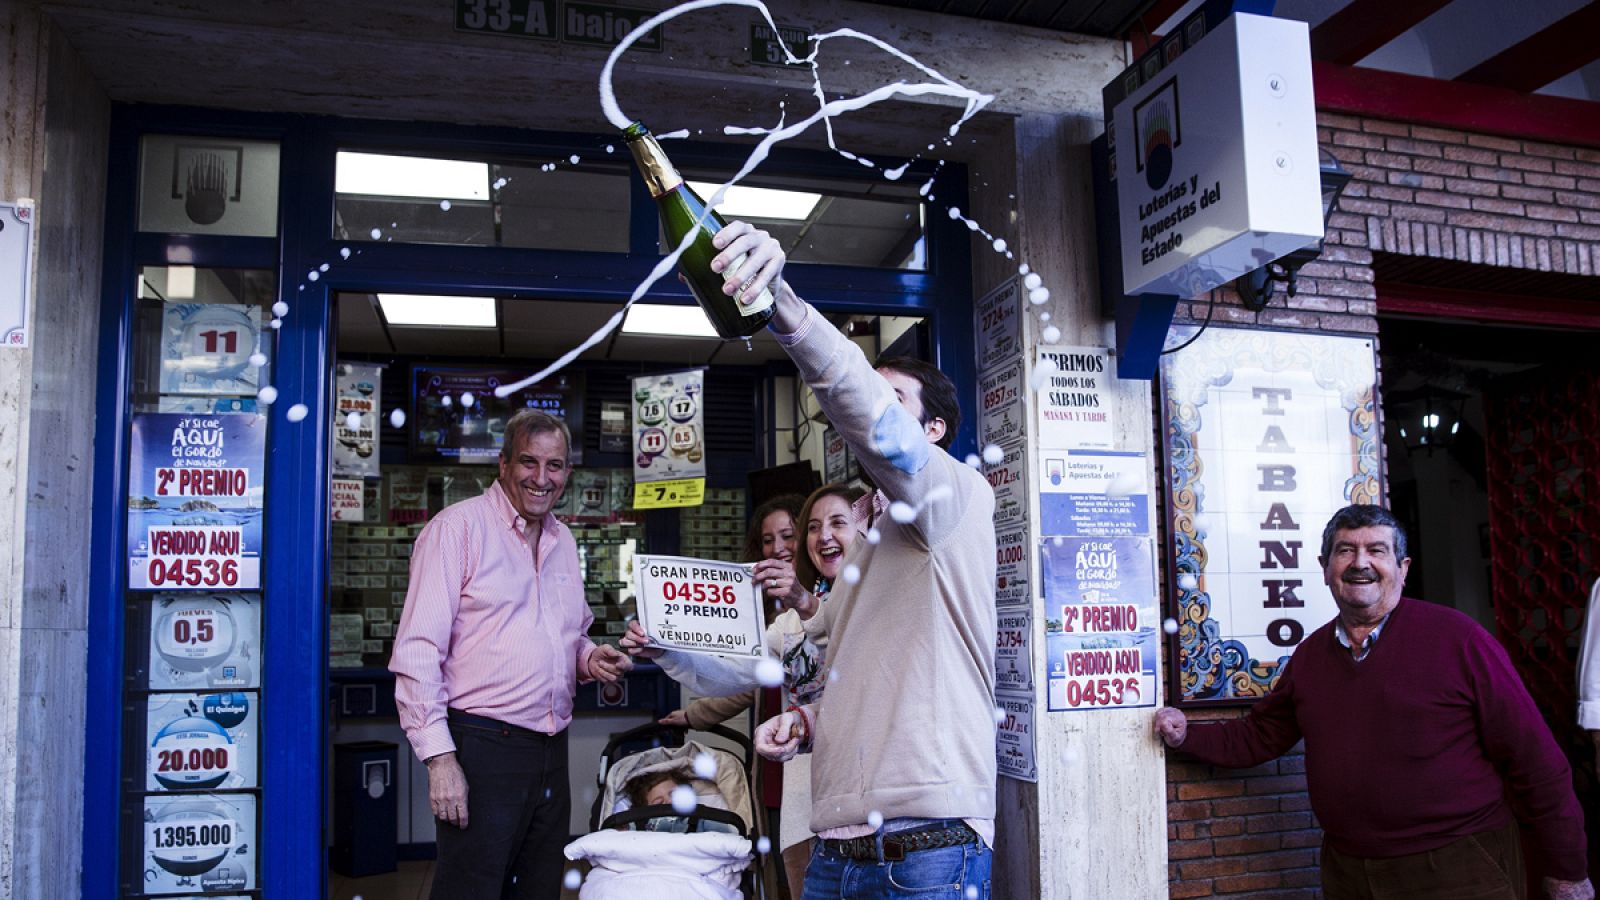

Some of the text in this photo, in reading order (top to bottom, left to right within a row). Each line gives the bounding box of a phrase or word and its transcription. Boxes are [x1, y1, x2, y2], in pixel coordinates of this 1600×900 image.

[463, 0, 549, 35] 33-A
[1139, 174, 1198, 221] Loterías y
[1141, 181, 1221, 244] Apuestas del
[1142, 232, 1183, 266] Estado
[200, 330, 237, 352] 11
[982, 367, 1018, 393] GRAN PREMIO
[1051, 376, 1096, 388] TODOS LOS
[676, 402, 690, 413] 17
[171, 427, 224, 448] AQUÍ
[646, 436, 660, 446] 11
[1001, 451, 1021, 465] REMIO
[157, 469, 246, 497] 2º PREMIO
[1069, 471, 1102, 480] Apuestas
[1252, 386, 1304, 647] TABANKO
[151, 530, 240, 556] VENDIDO AQUI
[1001, 532, 1023, 545] PREMIO
[1075, 550, 1117, 570] AQUÍ
[149, 558, 238, 587] 04536
[650, 565, 744, 583] GRAN PREMIO
[662, 581, 736, 605] 04536
[664, 603, 739, 620] 2º PREMIO
[1004, 617, 1026, 629] PREMIO
[1063, 605, 1137, 632] 2º PREMIO
[174, 618, 214, 646] 0,5
[658, 630, 746, 646] VENDIDO AQUÍ
[1066, 649, 1140, 676] VENDIDO AQUI
[1007, 701, 1029, 714] PREMIO
[158, 748, 228, 772] 20.000
[153, 824, 231, 848] 1.395.000
